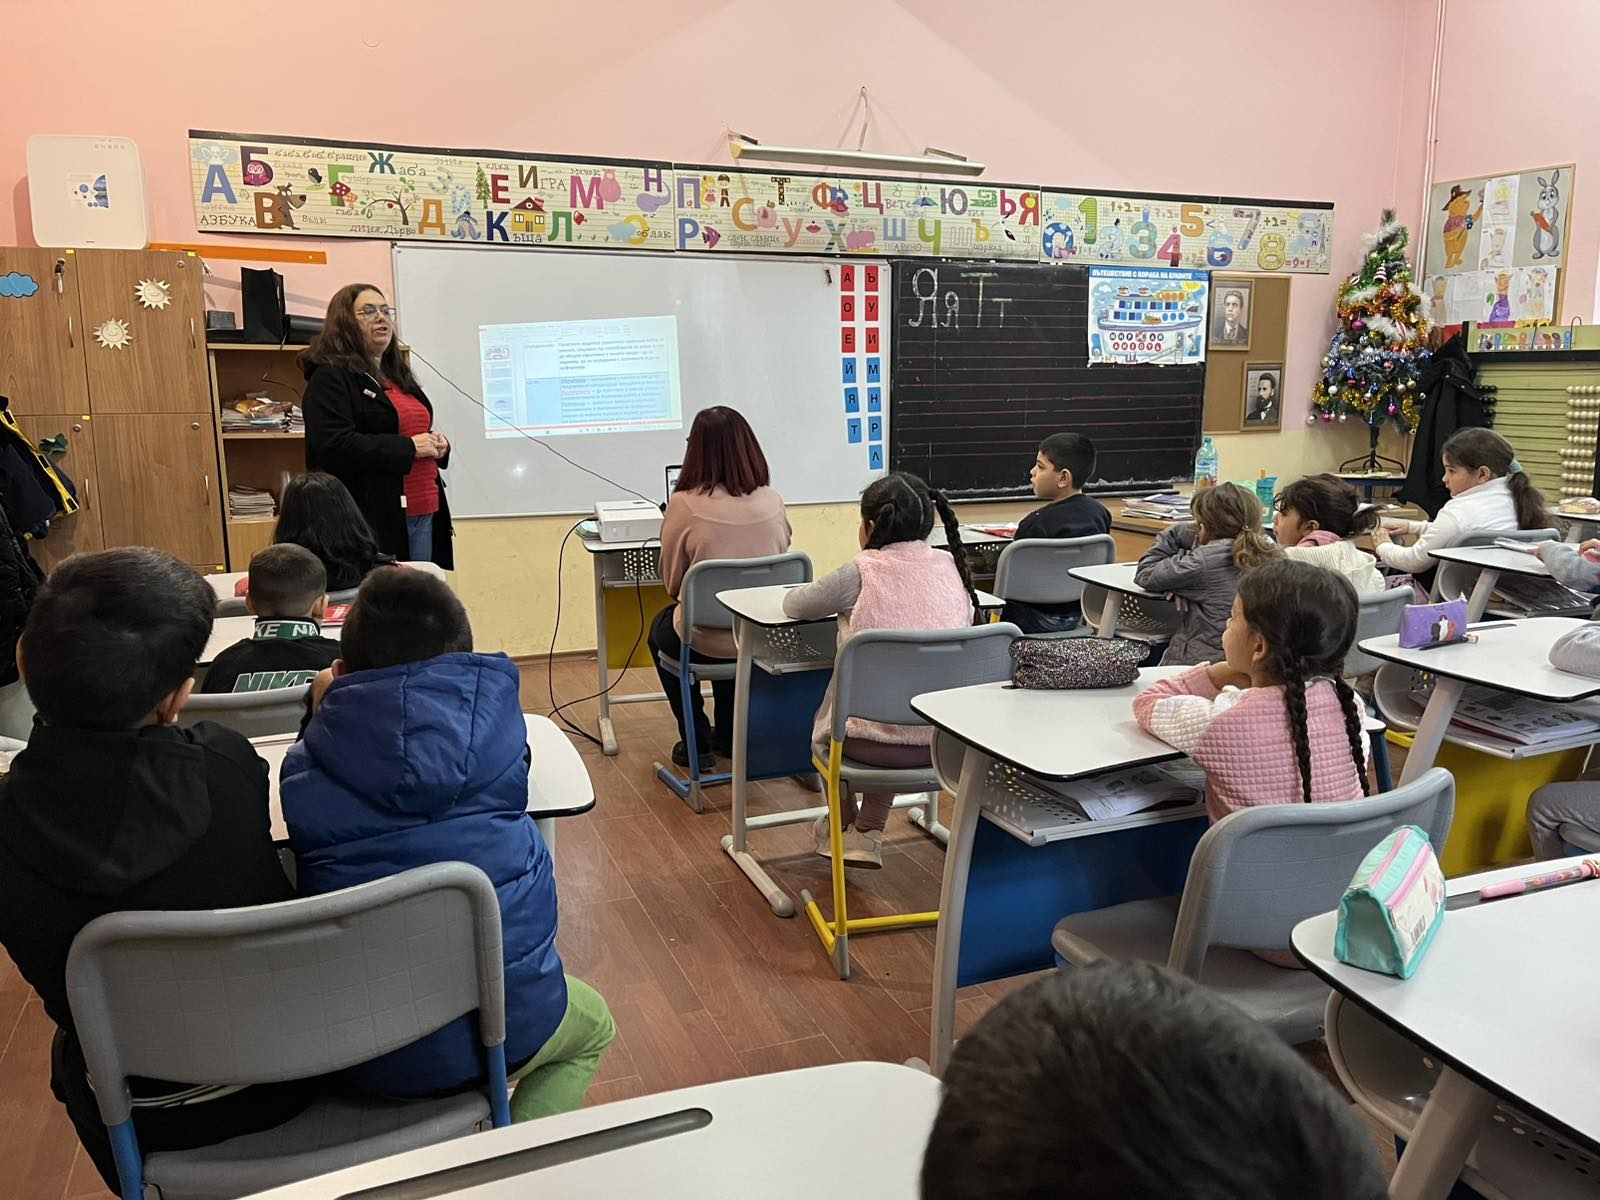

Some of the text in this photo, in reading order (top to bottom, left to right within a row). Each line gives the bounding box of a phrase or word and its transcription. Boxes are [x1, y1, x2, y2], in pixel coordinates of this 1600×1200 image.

[240, 146, 273, 185] Б
[644, 167, 662, 192] Н
[201, 164, 238, 204] А
[328, 164, 354, 206] Г
[491, 174, 511, 204] Е
[570, 175, 604, 210] М
[677, 178, 700, 208] П
[771, 177, 790, 205] Т
[863, 182, 883, 215] Ц
[254, 192, 282, 229] В
[418, 199, 446, 235] Д
[732, 197, 757, 232] С
[940, 188, 968, 215] Ю
[1000, 190, 1017, 216] Ь
[1018, 192, 1039, 226] Я
[200, 215, 257, 226] АЗБУКА
[486, 211, 509, 241] К
[548, 211, 572, 242] Л
[679, 218, 699, 249] Р
[782, 218, 803, 248] У
[825, 220, 848, 251] Х
[883, 218, 906, 241] Ш
[918, 219, 941, 255] Ч
[971, 219, 990, 243] Ъ
[1078, 197, 1097, 244] 1
[1180, 204, 1204, 237] 5
[1233, 208, 1261, 250] 7
[1099, 226, 1124, 259] 2
[1129, 221, 1157, 259] 3
[1157, 234, 1182, 267] 4
[1207, 231, 1233, 267] 6
[1257, 233, 1286, 270] 8
[232, 671, 319, 694] NIKE
